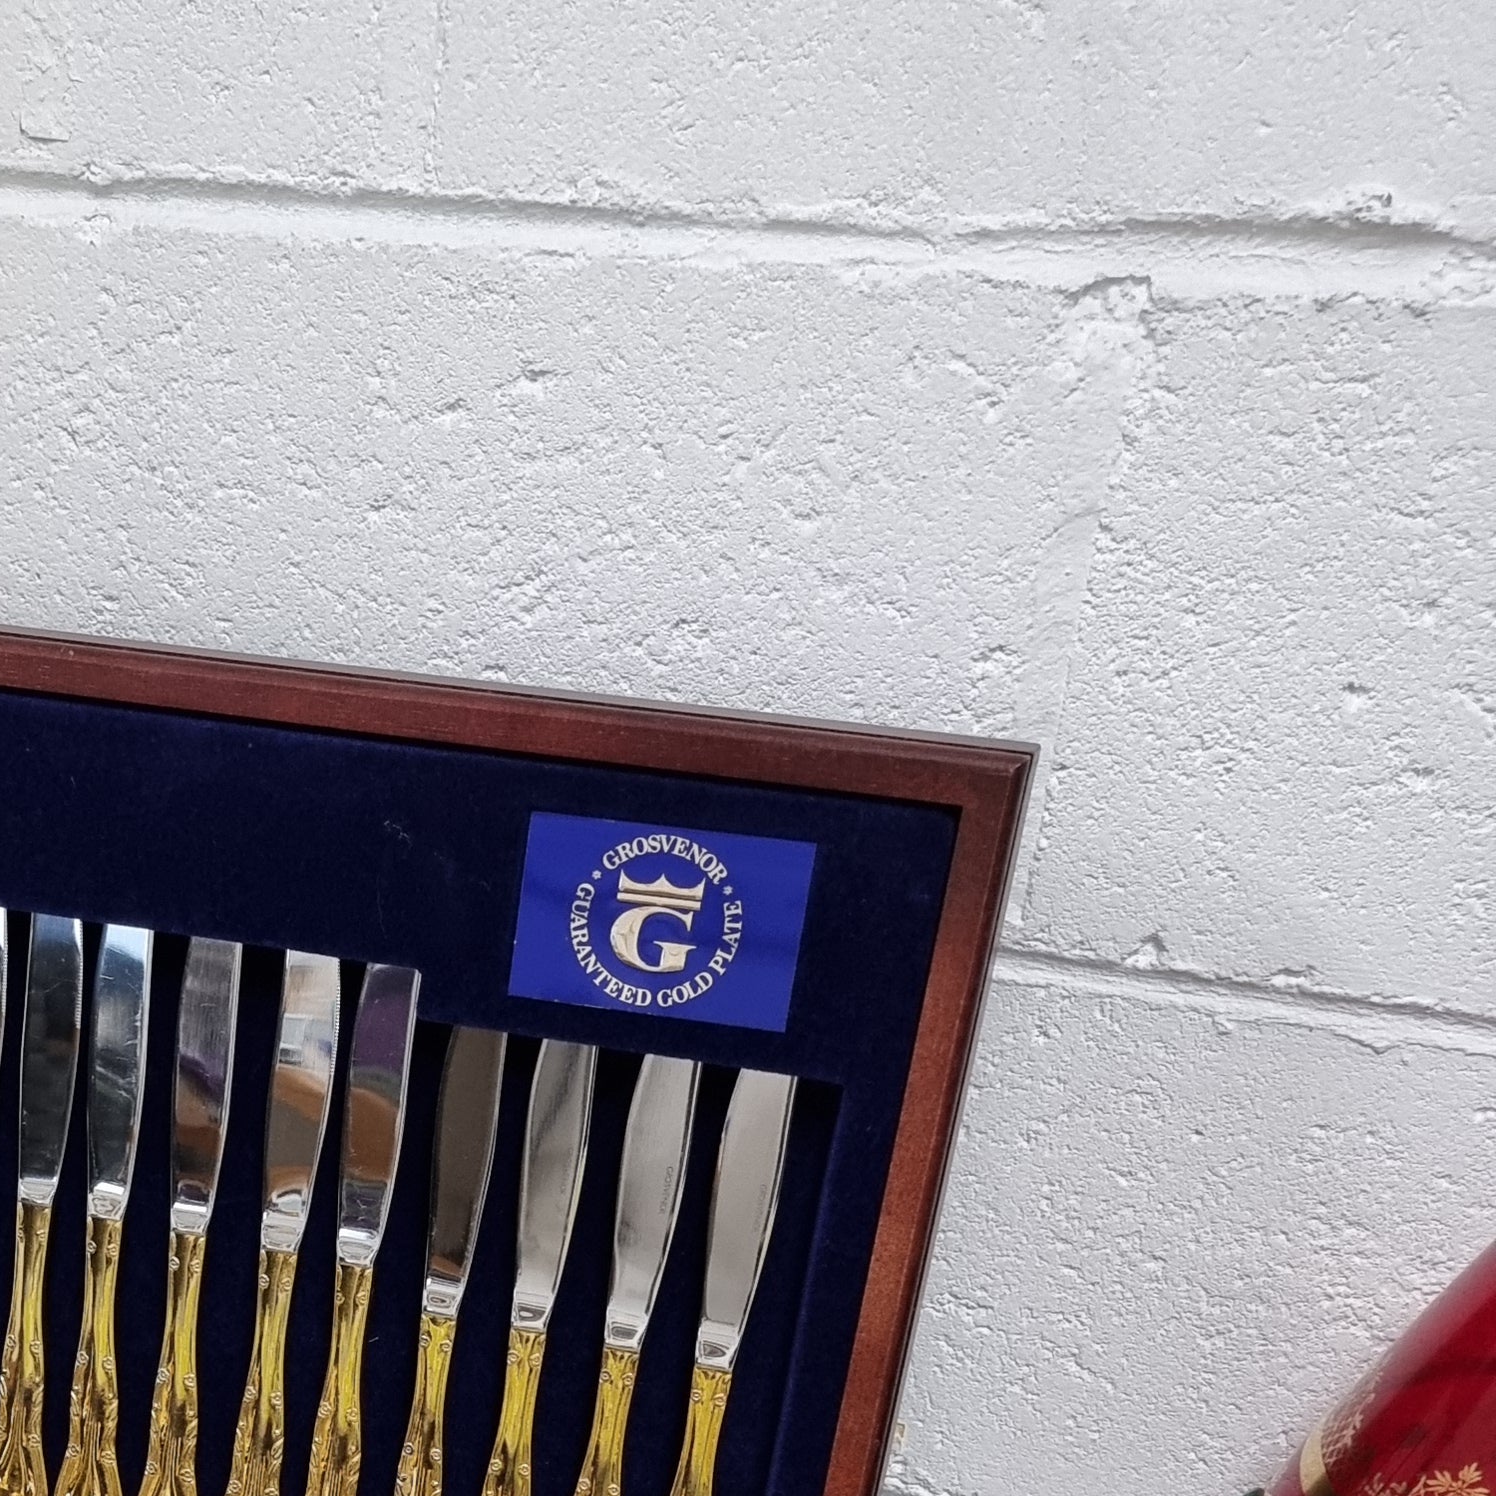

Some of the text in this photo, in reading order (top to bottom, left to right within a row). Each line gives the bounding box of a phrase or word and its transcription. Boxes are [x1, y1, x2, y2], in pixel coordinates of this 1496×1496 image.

[602, 834, 728, 885] GROSVENOR
[570, 883, 743, 1008] GUARANTEED GOLD PLATE
[610, 905, 697, 973] G
